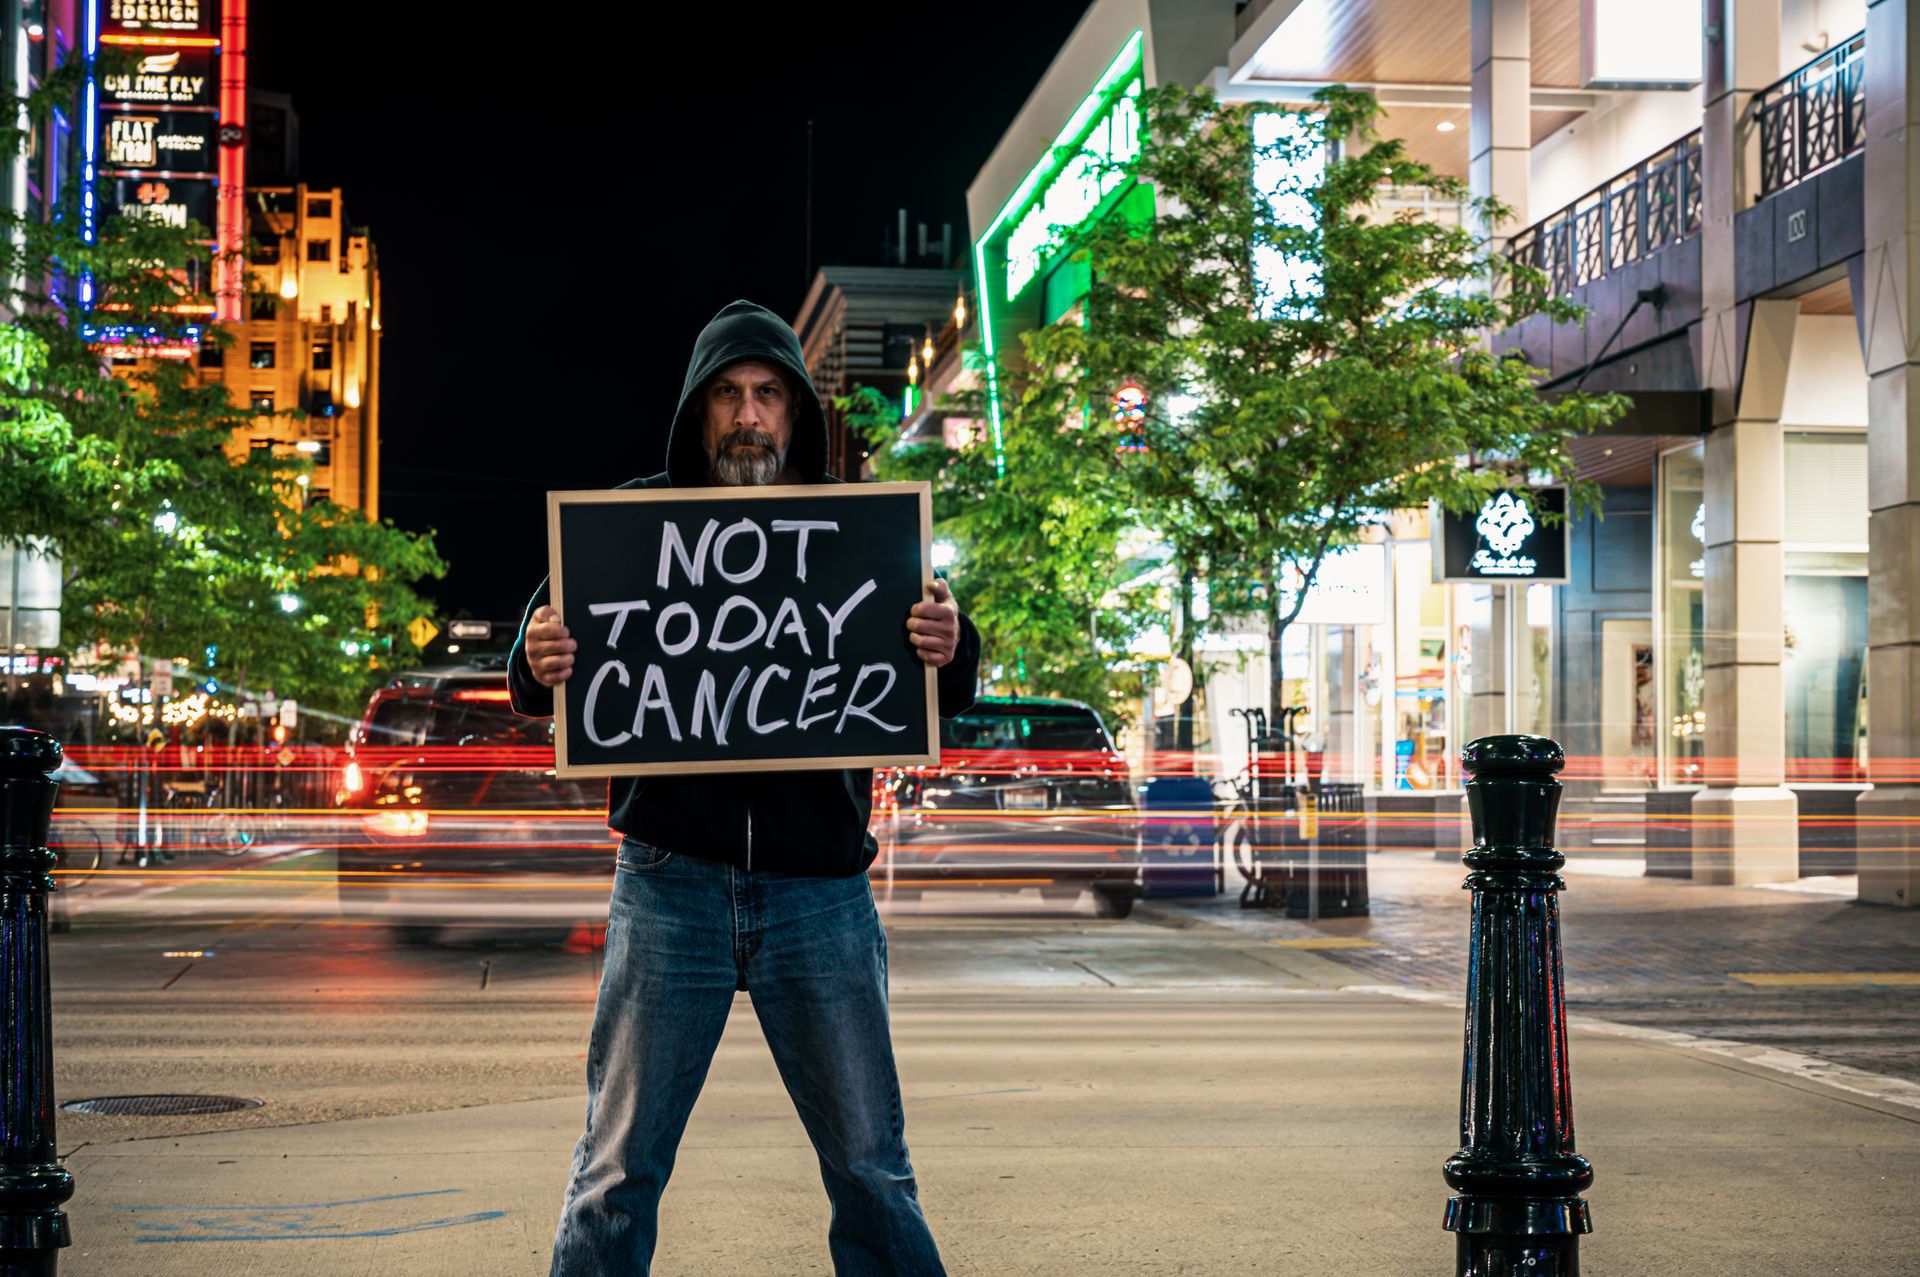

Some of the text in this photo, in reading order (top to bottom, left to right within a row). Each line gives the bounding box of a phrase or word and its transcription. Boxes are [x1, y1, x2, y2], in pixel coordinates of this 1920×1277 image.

[122, 4, 199, 21] DESIGN
[135, 75, 168, 92] THE
[170, 76, 204, 94] FLY
[112, 120, 155, 141] FLAT
[657, 517, 839, 590] NOT
[588, 579, 877, 659] TODAY
[583, 659, 907, 747] CANCER
